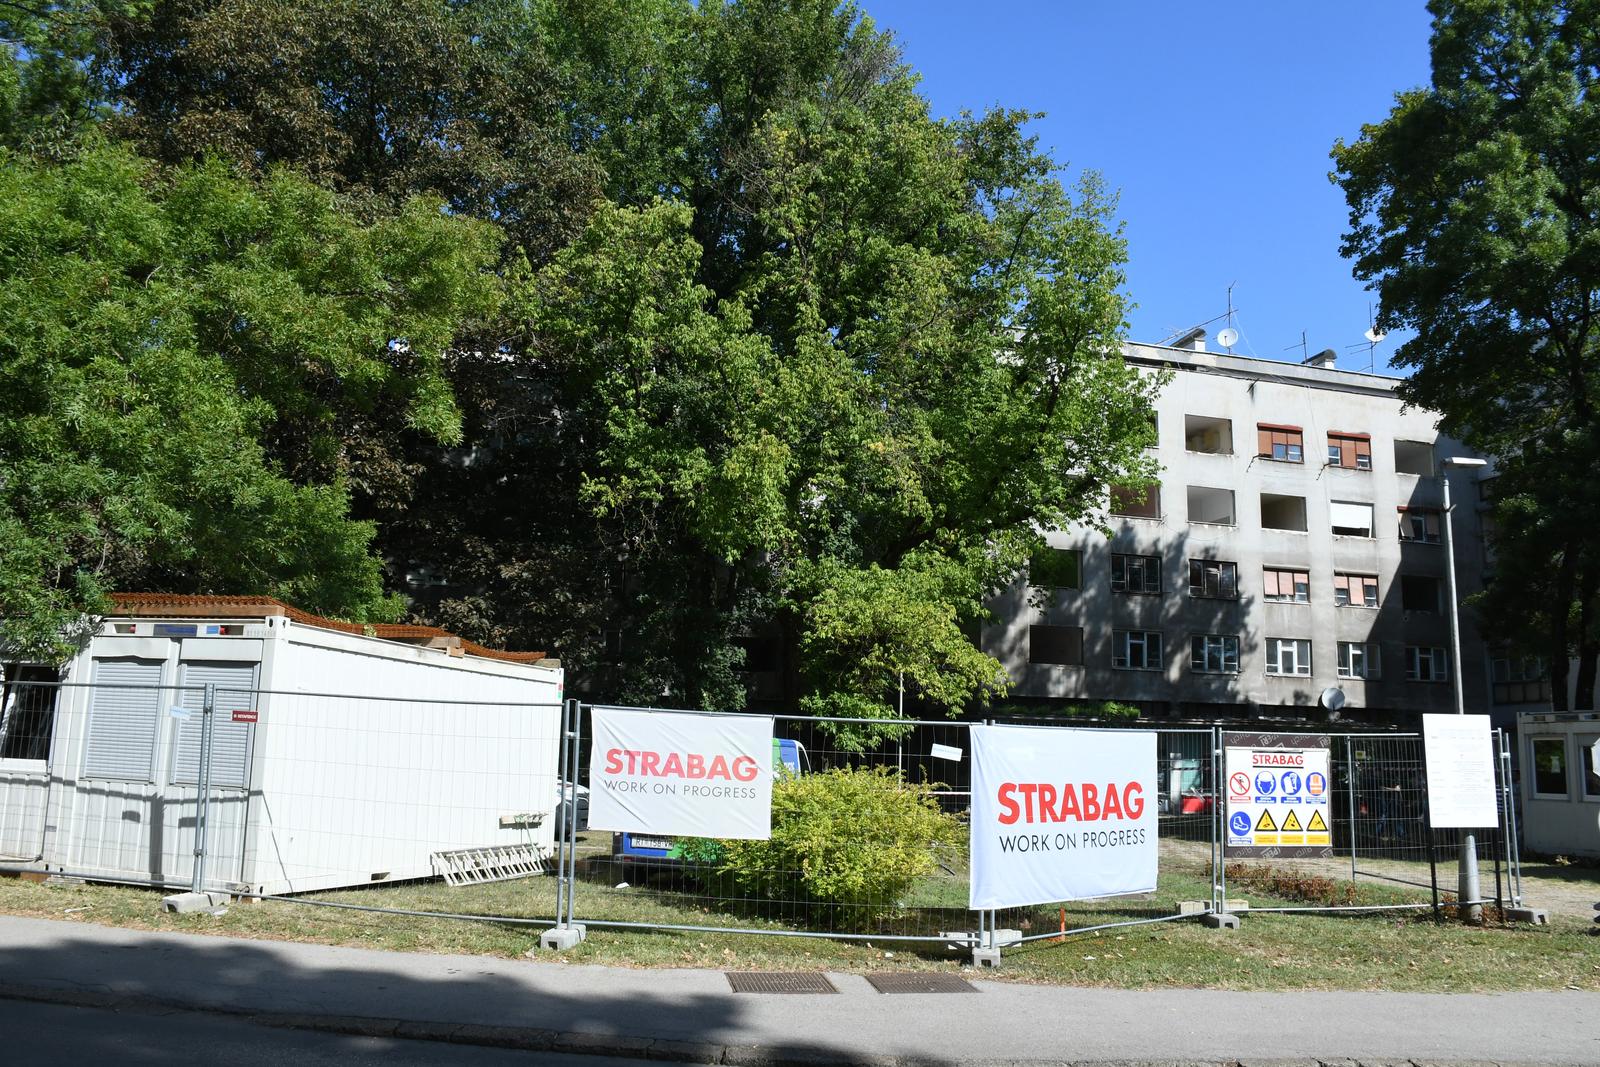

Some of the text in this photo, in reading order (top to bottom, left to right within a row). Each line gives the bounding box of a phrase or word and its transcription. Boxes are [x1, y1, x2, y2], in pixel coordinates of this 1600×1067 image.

[605, 748, 759, 782] STRABAG
[1252, 754, 1304, 765] STRABAG
[604, 780, 756, 799] WORK ON PROGRESS
[997, 781, 1145, 825] STRABAG
[999, 828, 1145, 853] WORK ON PROGRESS
